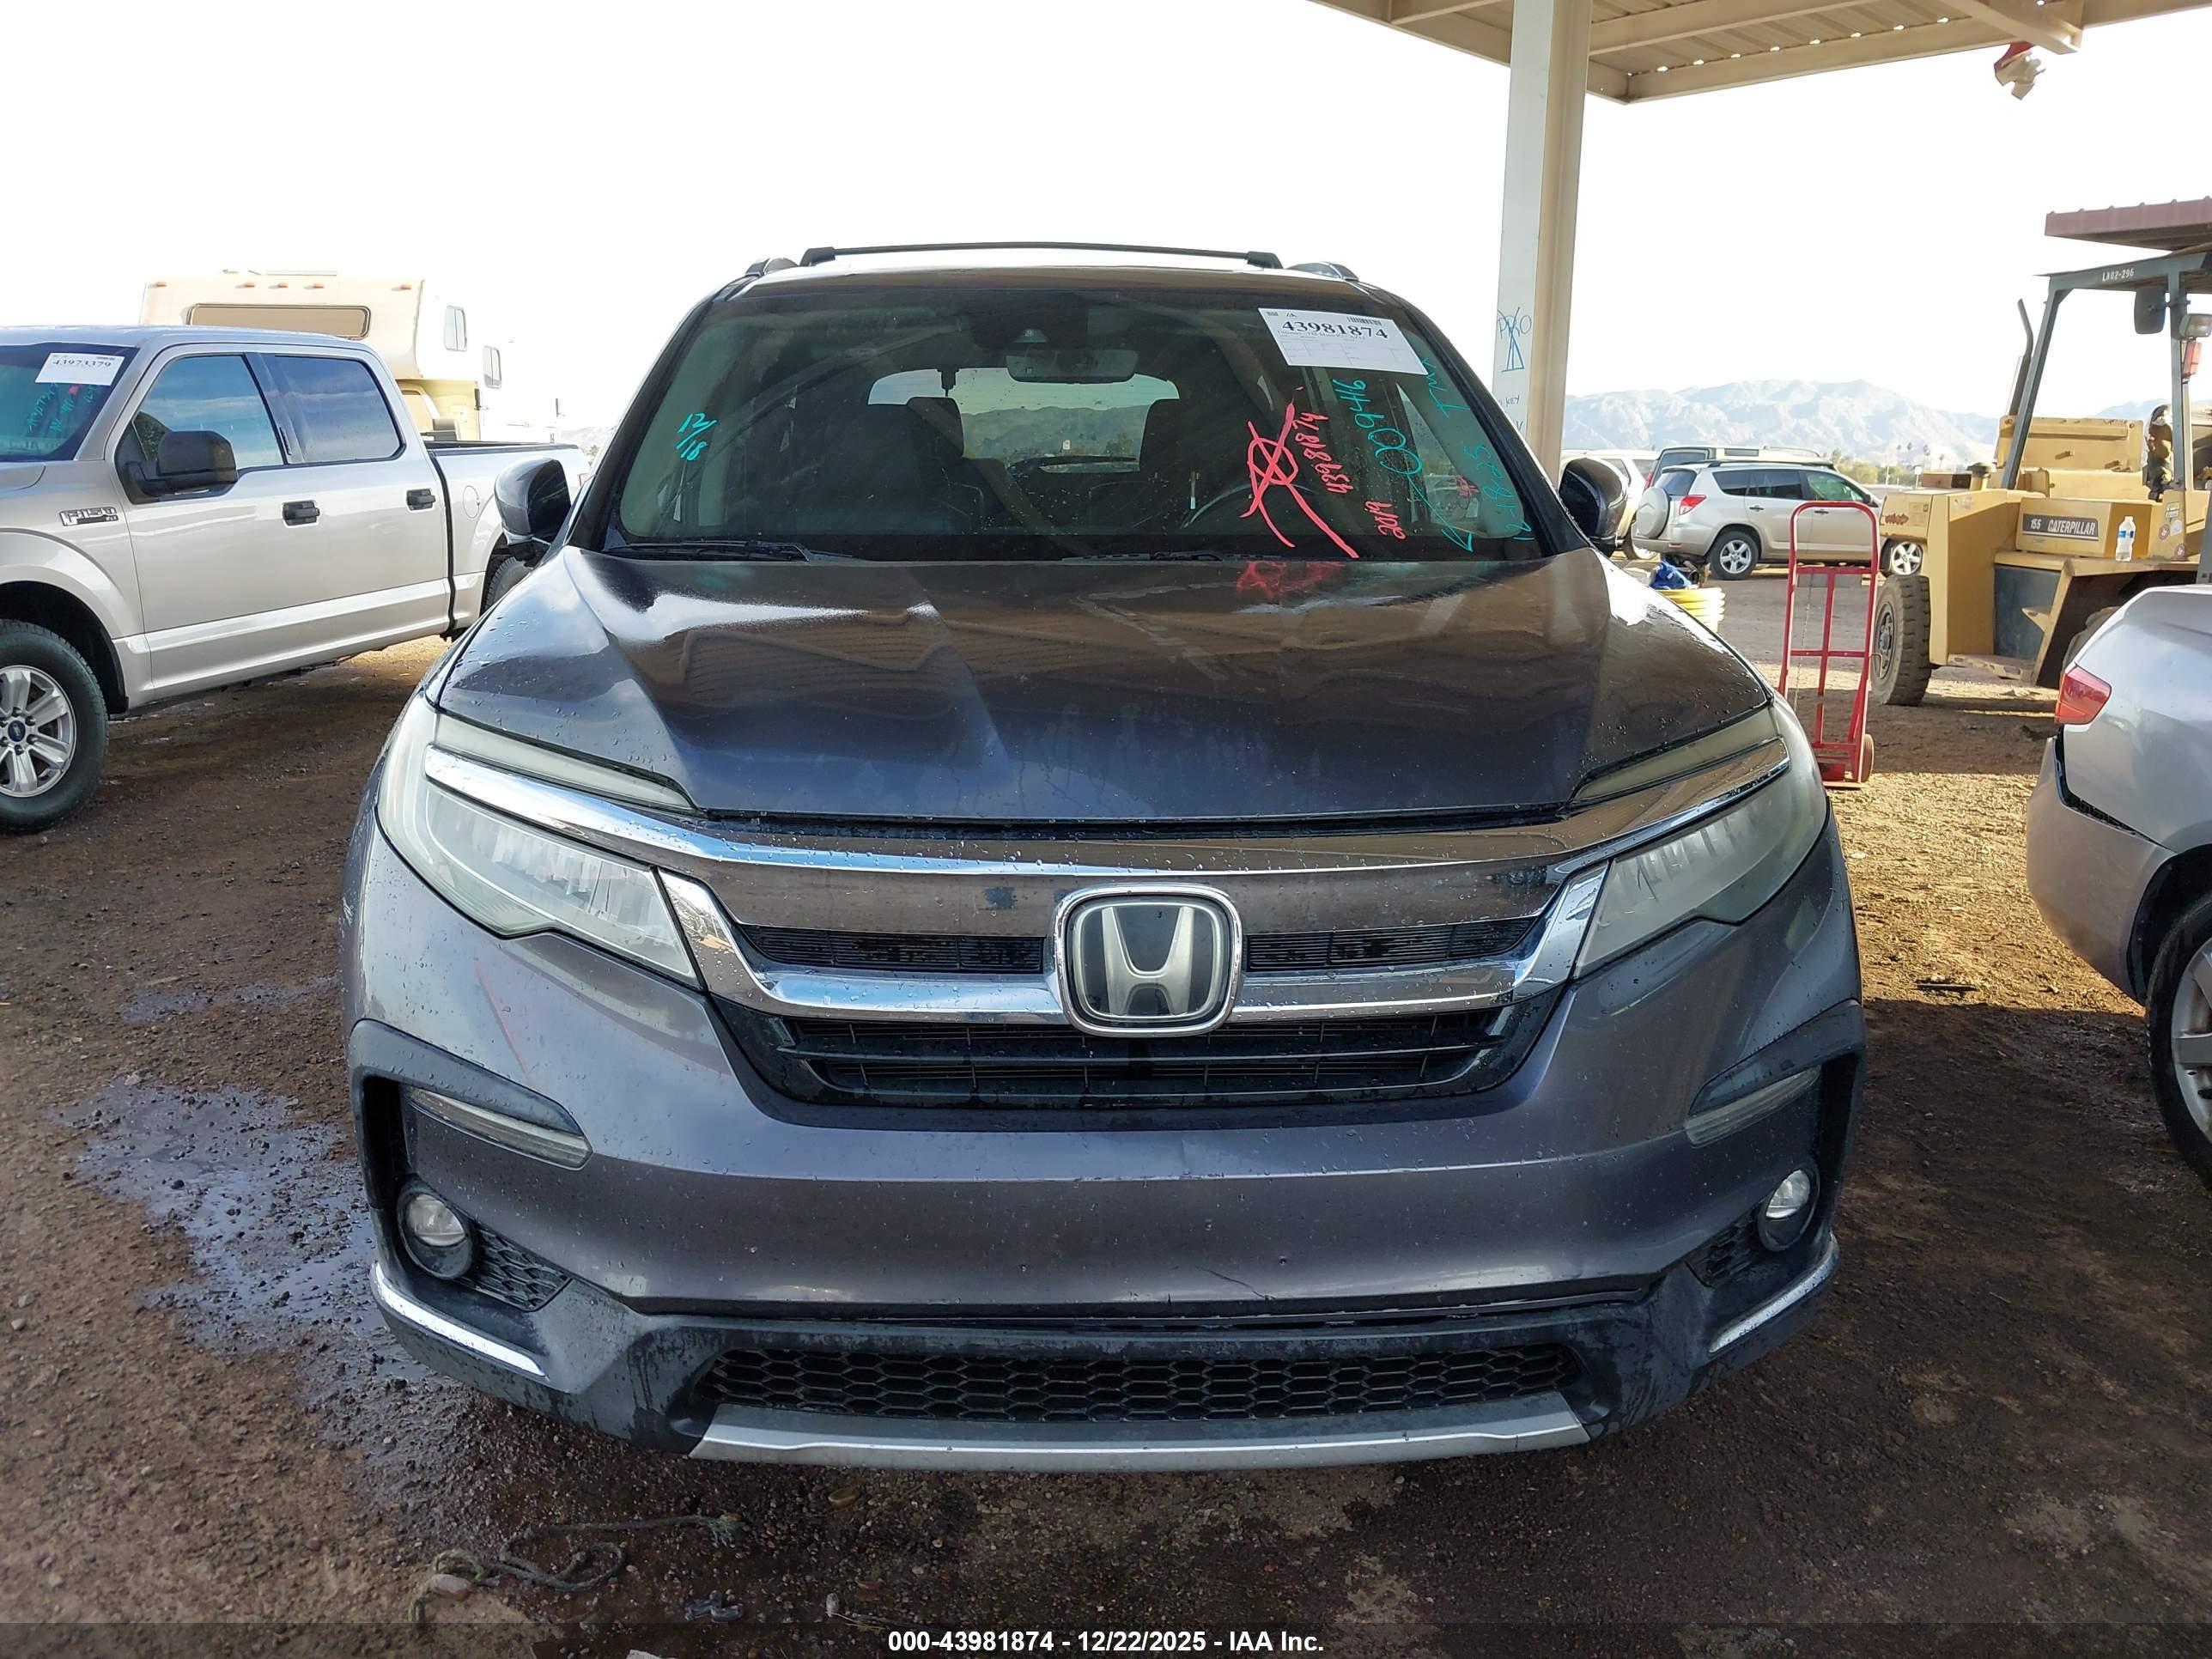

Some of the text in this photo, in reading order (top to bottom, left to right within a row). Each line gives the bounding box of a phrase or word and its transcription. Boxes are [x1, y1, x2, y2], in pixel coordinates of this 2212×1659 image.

[1281, 320, 1389, 339] 43981874
[1291, 411, 1354, 494] 43981874
[1364, 500, 1407, 540] 2019
[2047, 519, 2096, 535] CATERPILLAR
